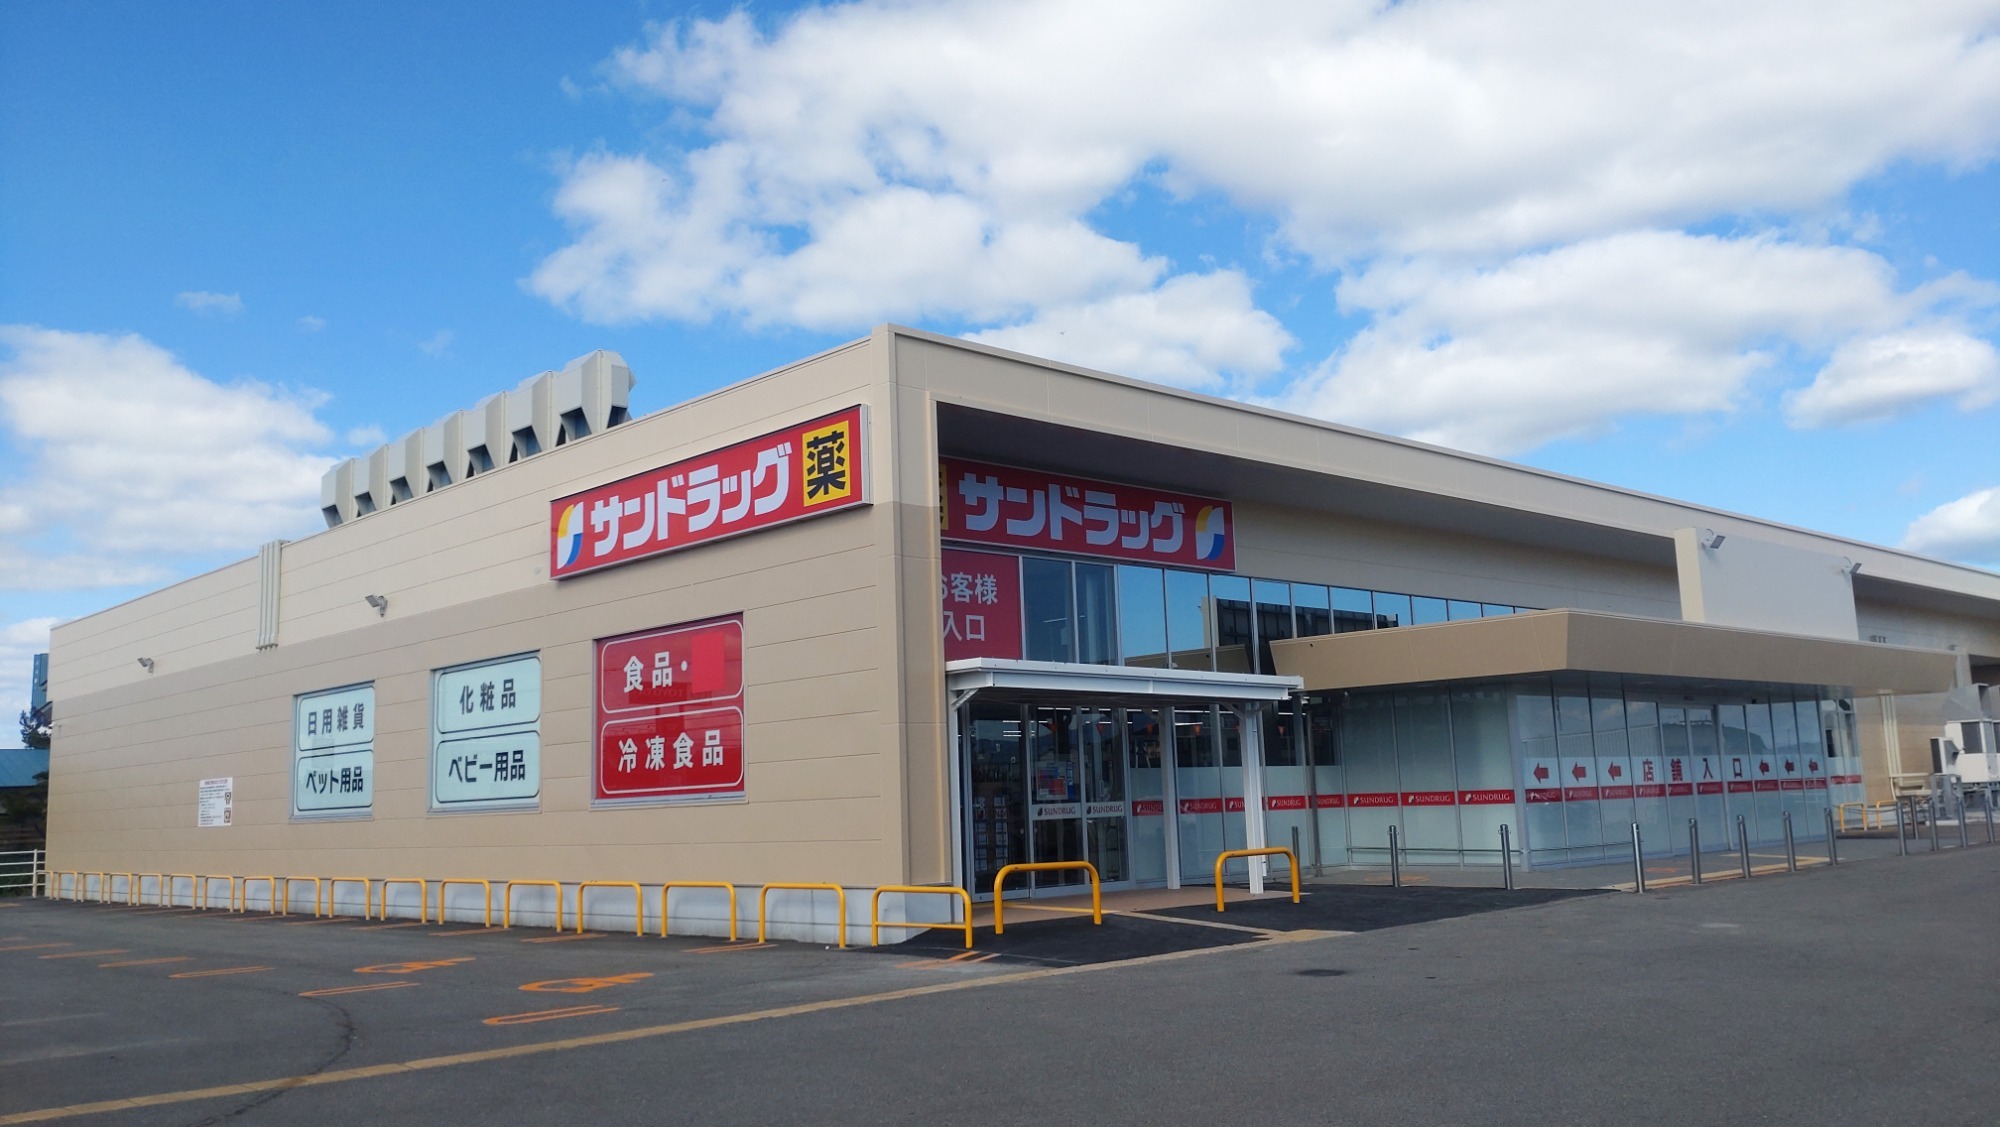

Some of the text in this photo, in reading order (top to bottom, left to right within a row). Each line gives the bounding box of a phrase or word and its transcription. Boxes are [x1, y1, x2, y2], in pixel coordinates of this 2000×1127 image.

[590, 441, 792, 557] サンドラッグ
[806, 430, 845, 499] 薬
[958, 472, 1186, 553] サンドラッグ
[943, 611, 985, 641] 入口
[459, 678, 516, 715] 化粧品
[307, 703, 365, 736] 日用雑貨
[448, 750, 526, 783] ベビー用品
[617, 729, 724, 774] 冷凍食品
[306, 766, 364, 794] ペット用品
[1044, 805, 1076, 816] SUNDRUG
[1092, 804, 1123, 814] SUNDRUG
[1360, 796, 1394, 804] SUNDRUG
[1415, 794, 1451, 803] SUNDRUG
[1472, 793, 1510, 801] SUNDRUG
